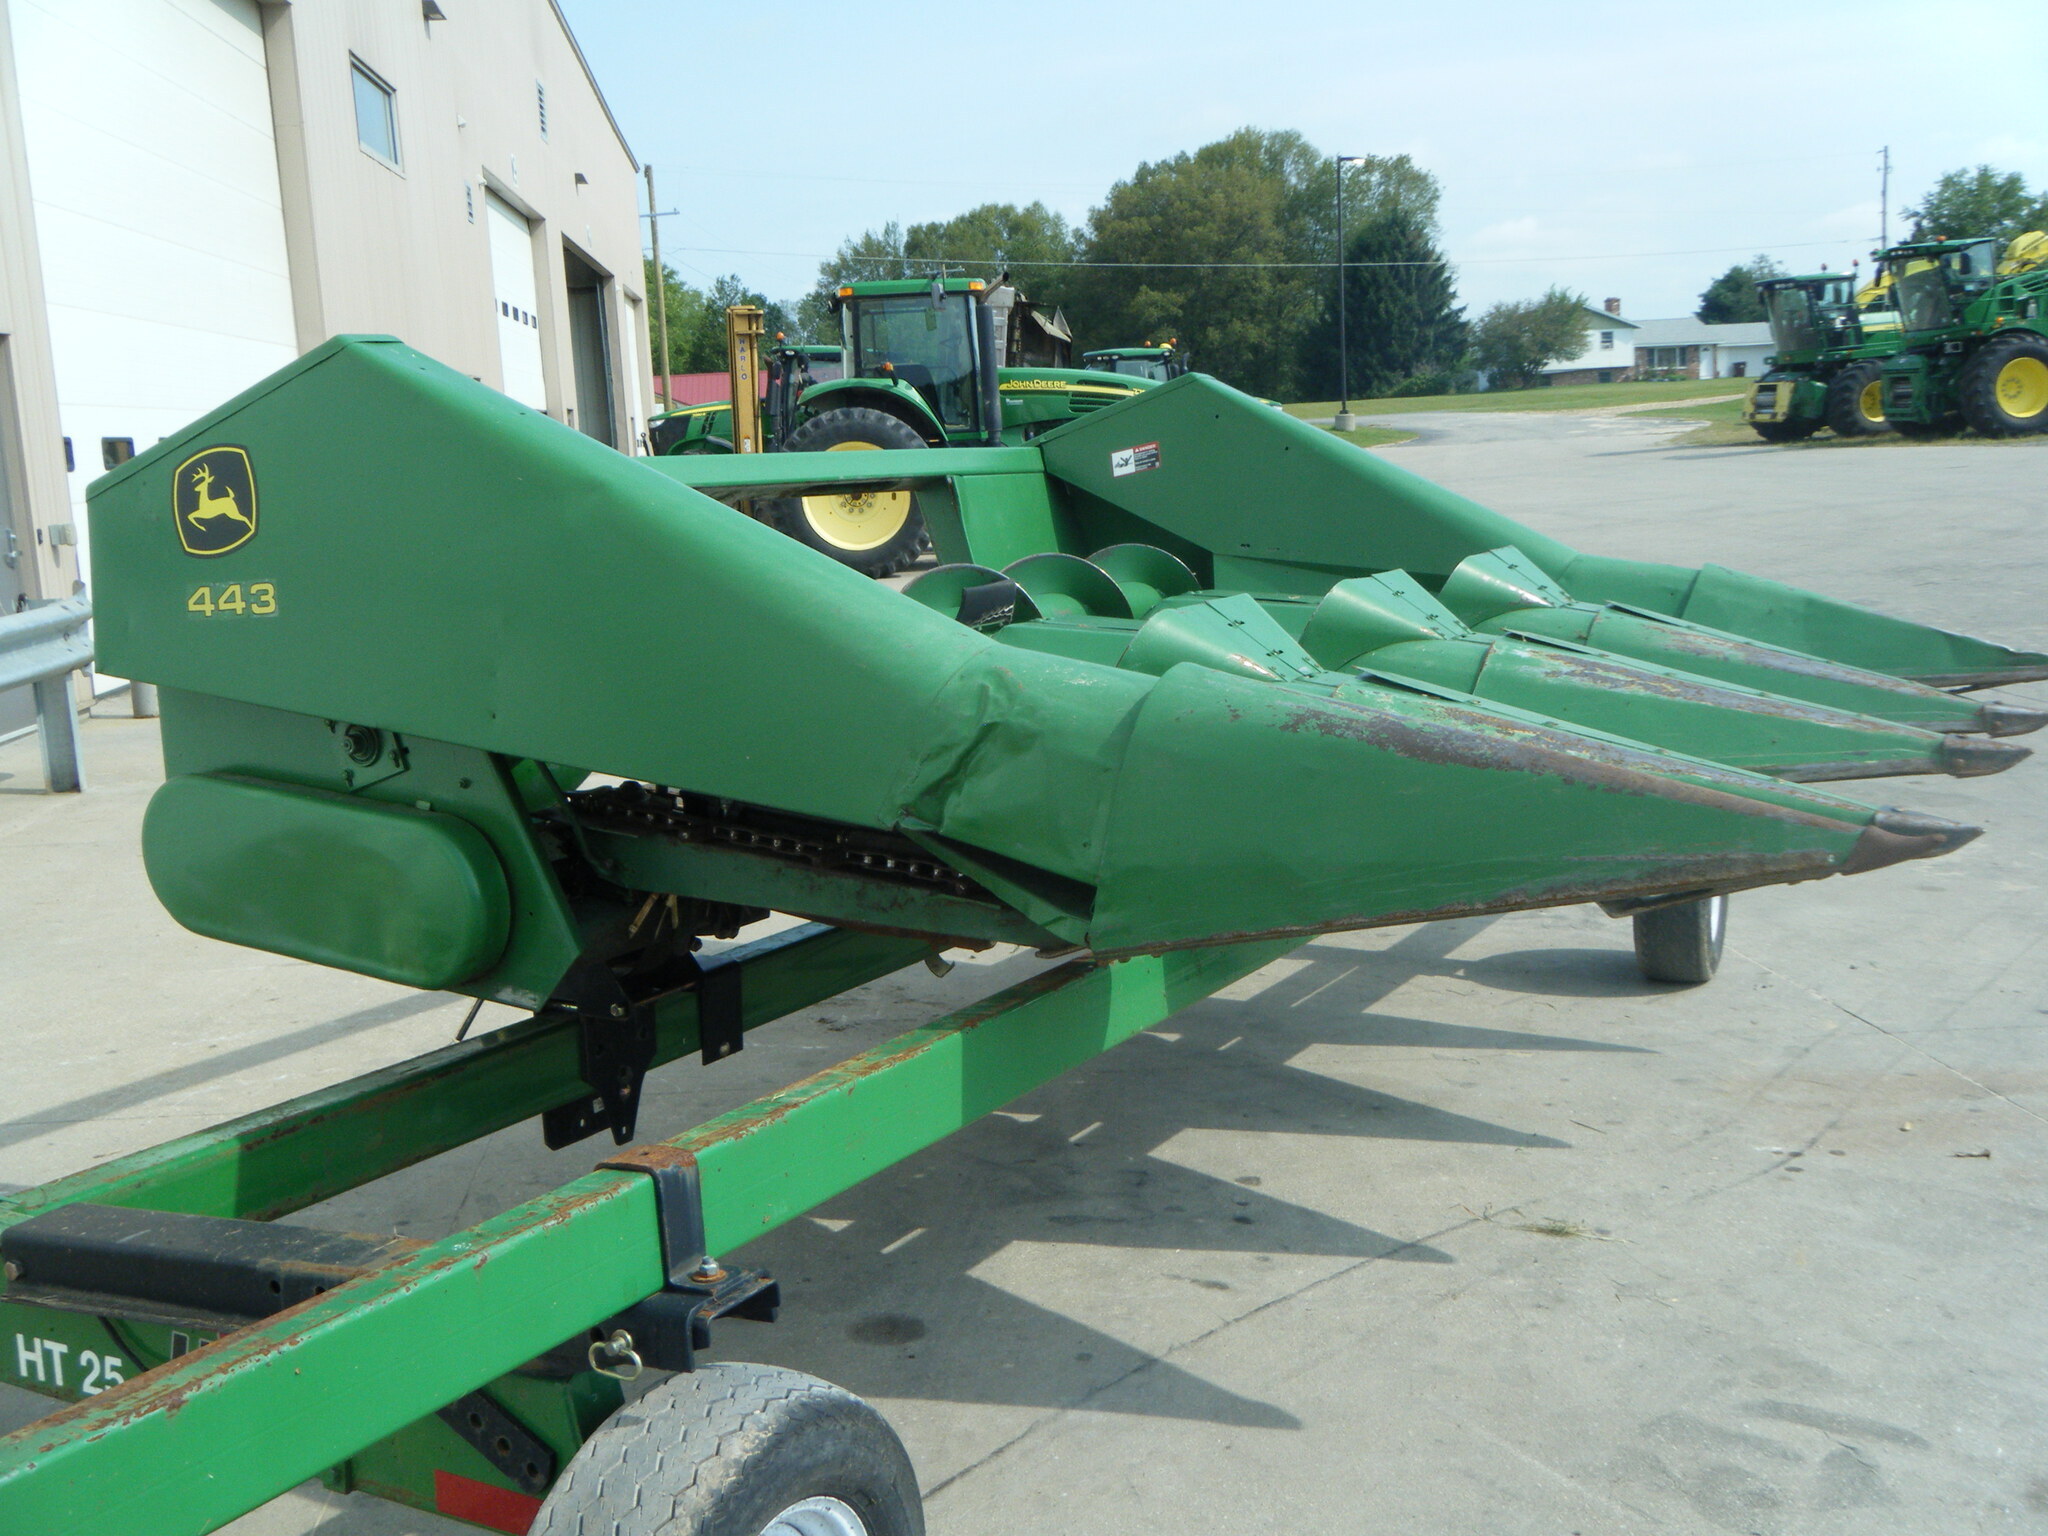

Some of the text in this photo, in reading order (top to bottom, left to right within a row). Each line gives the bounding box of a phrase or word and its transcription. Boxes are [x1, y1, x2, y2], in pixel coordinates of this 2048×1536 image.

[1006, 379, 1067, 389] JOHN DEERE
[187, 583, 276, 617] 443
[15, 1333, 125, 1396] HT 25
